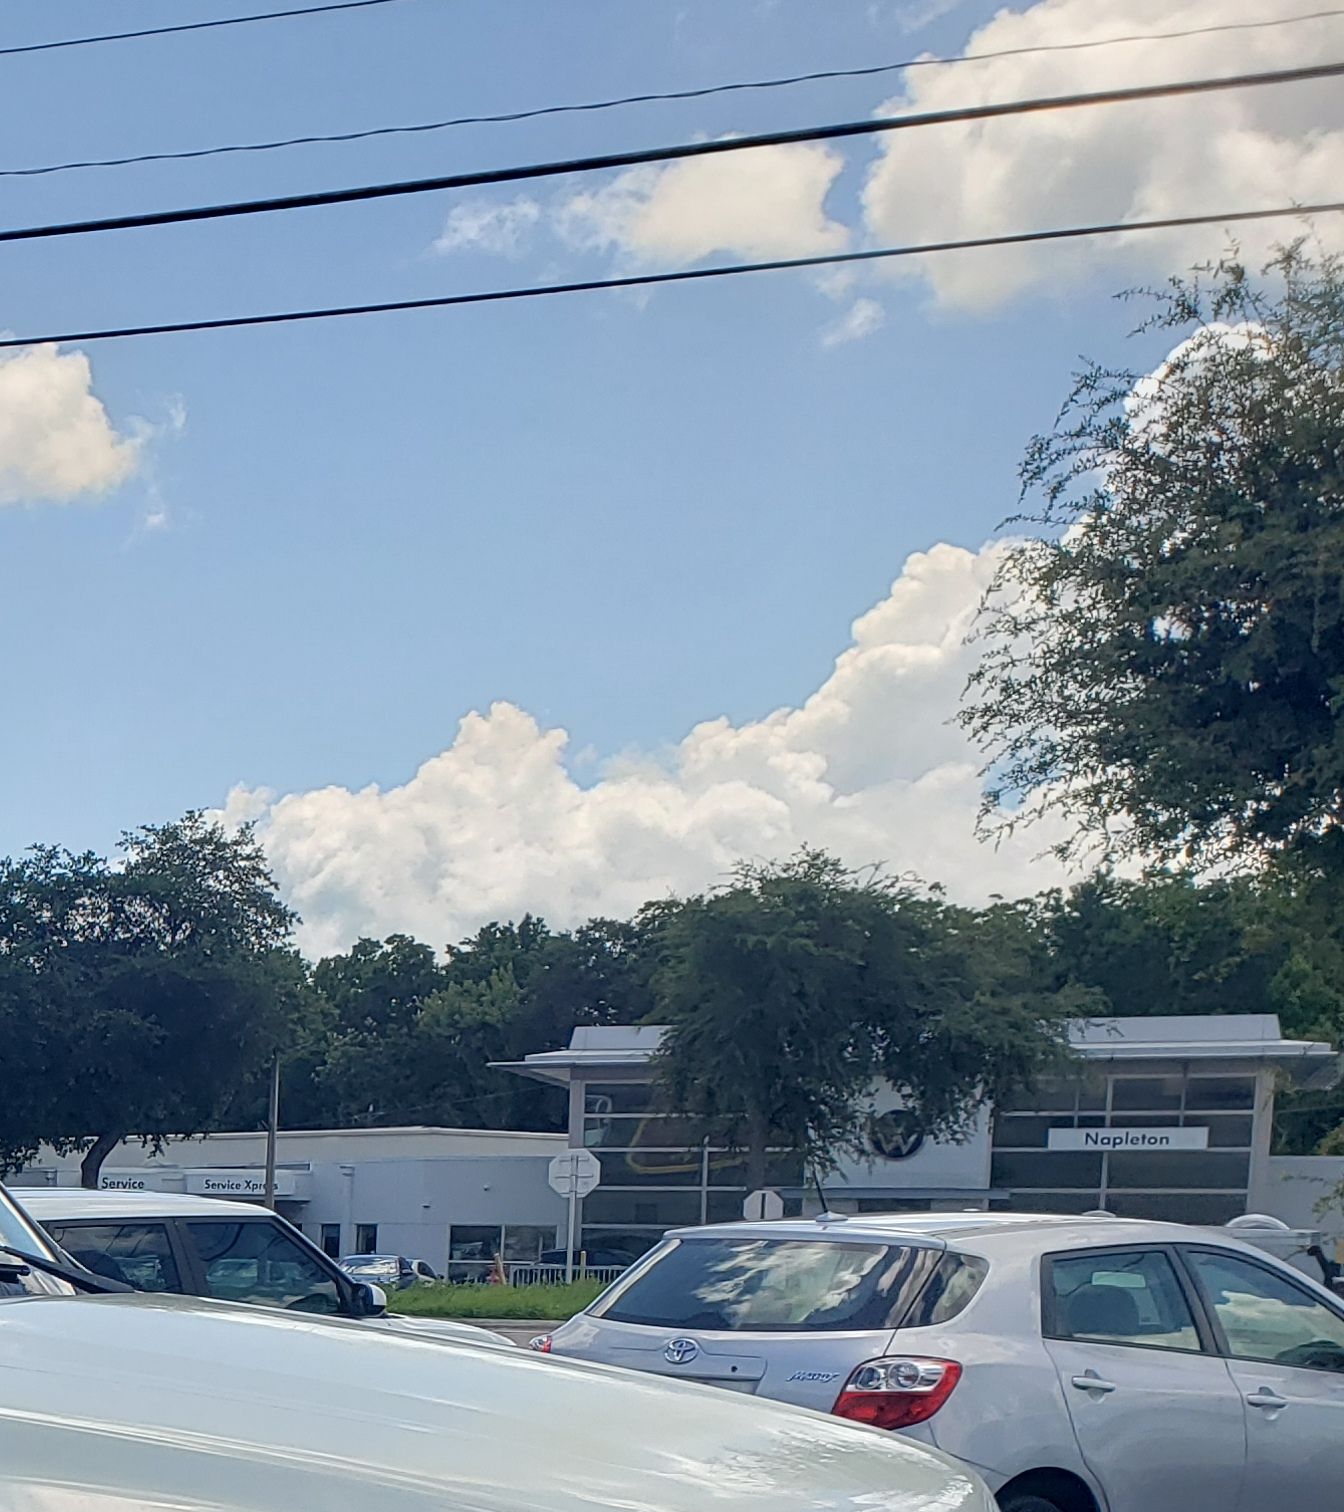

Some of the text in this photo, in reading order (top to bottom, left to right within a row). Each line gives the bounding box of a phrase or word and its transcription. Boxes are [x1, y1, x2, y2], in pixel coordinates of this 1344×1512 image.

[1085, 1131, 1169, 1148] Napleton
[101, 1177, 145, 1190] Service
[204, 1179, 279, 1192] Service Xprs
